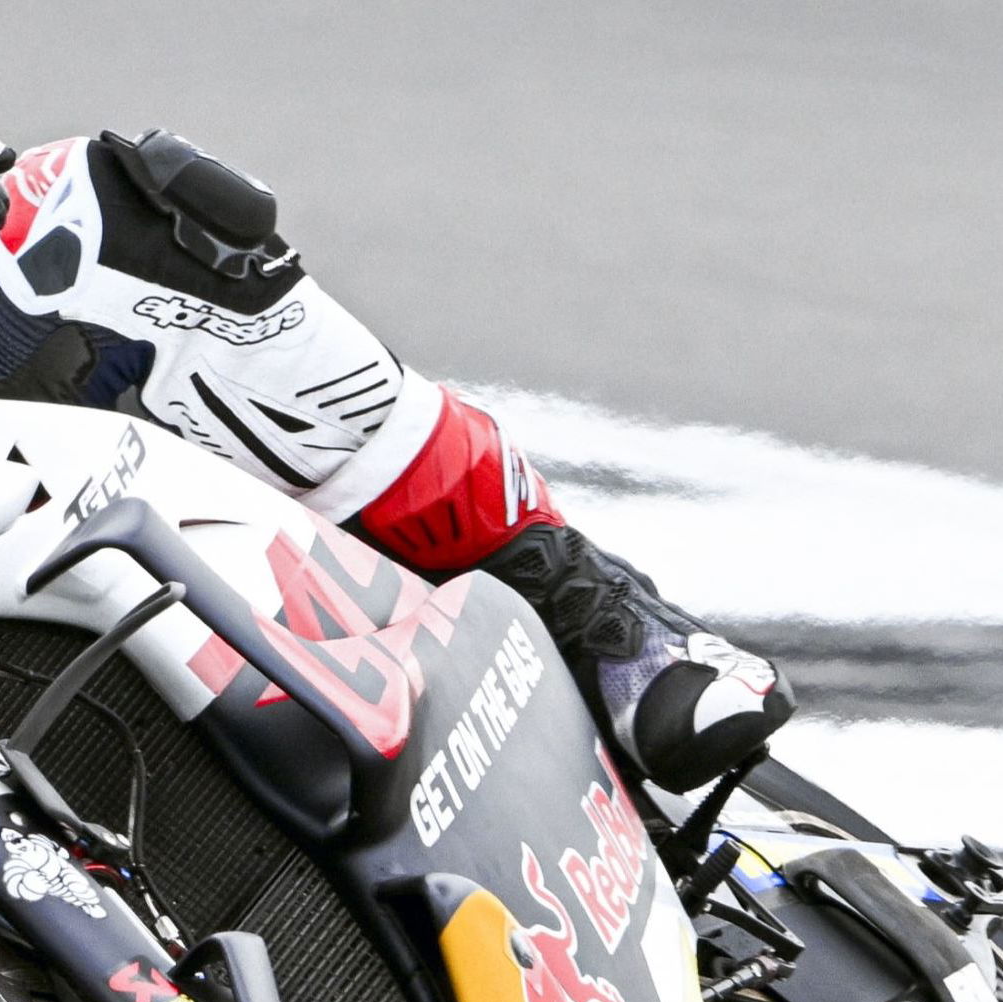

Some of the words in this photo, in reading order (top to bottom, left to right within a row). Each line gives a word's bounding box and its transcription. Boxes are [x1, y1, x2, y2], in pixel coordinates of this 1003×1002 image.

[447, 711, 493, 791] ON
[469, 667, 519, 751] THE
[410, 749, 464, 848] GET
